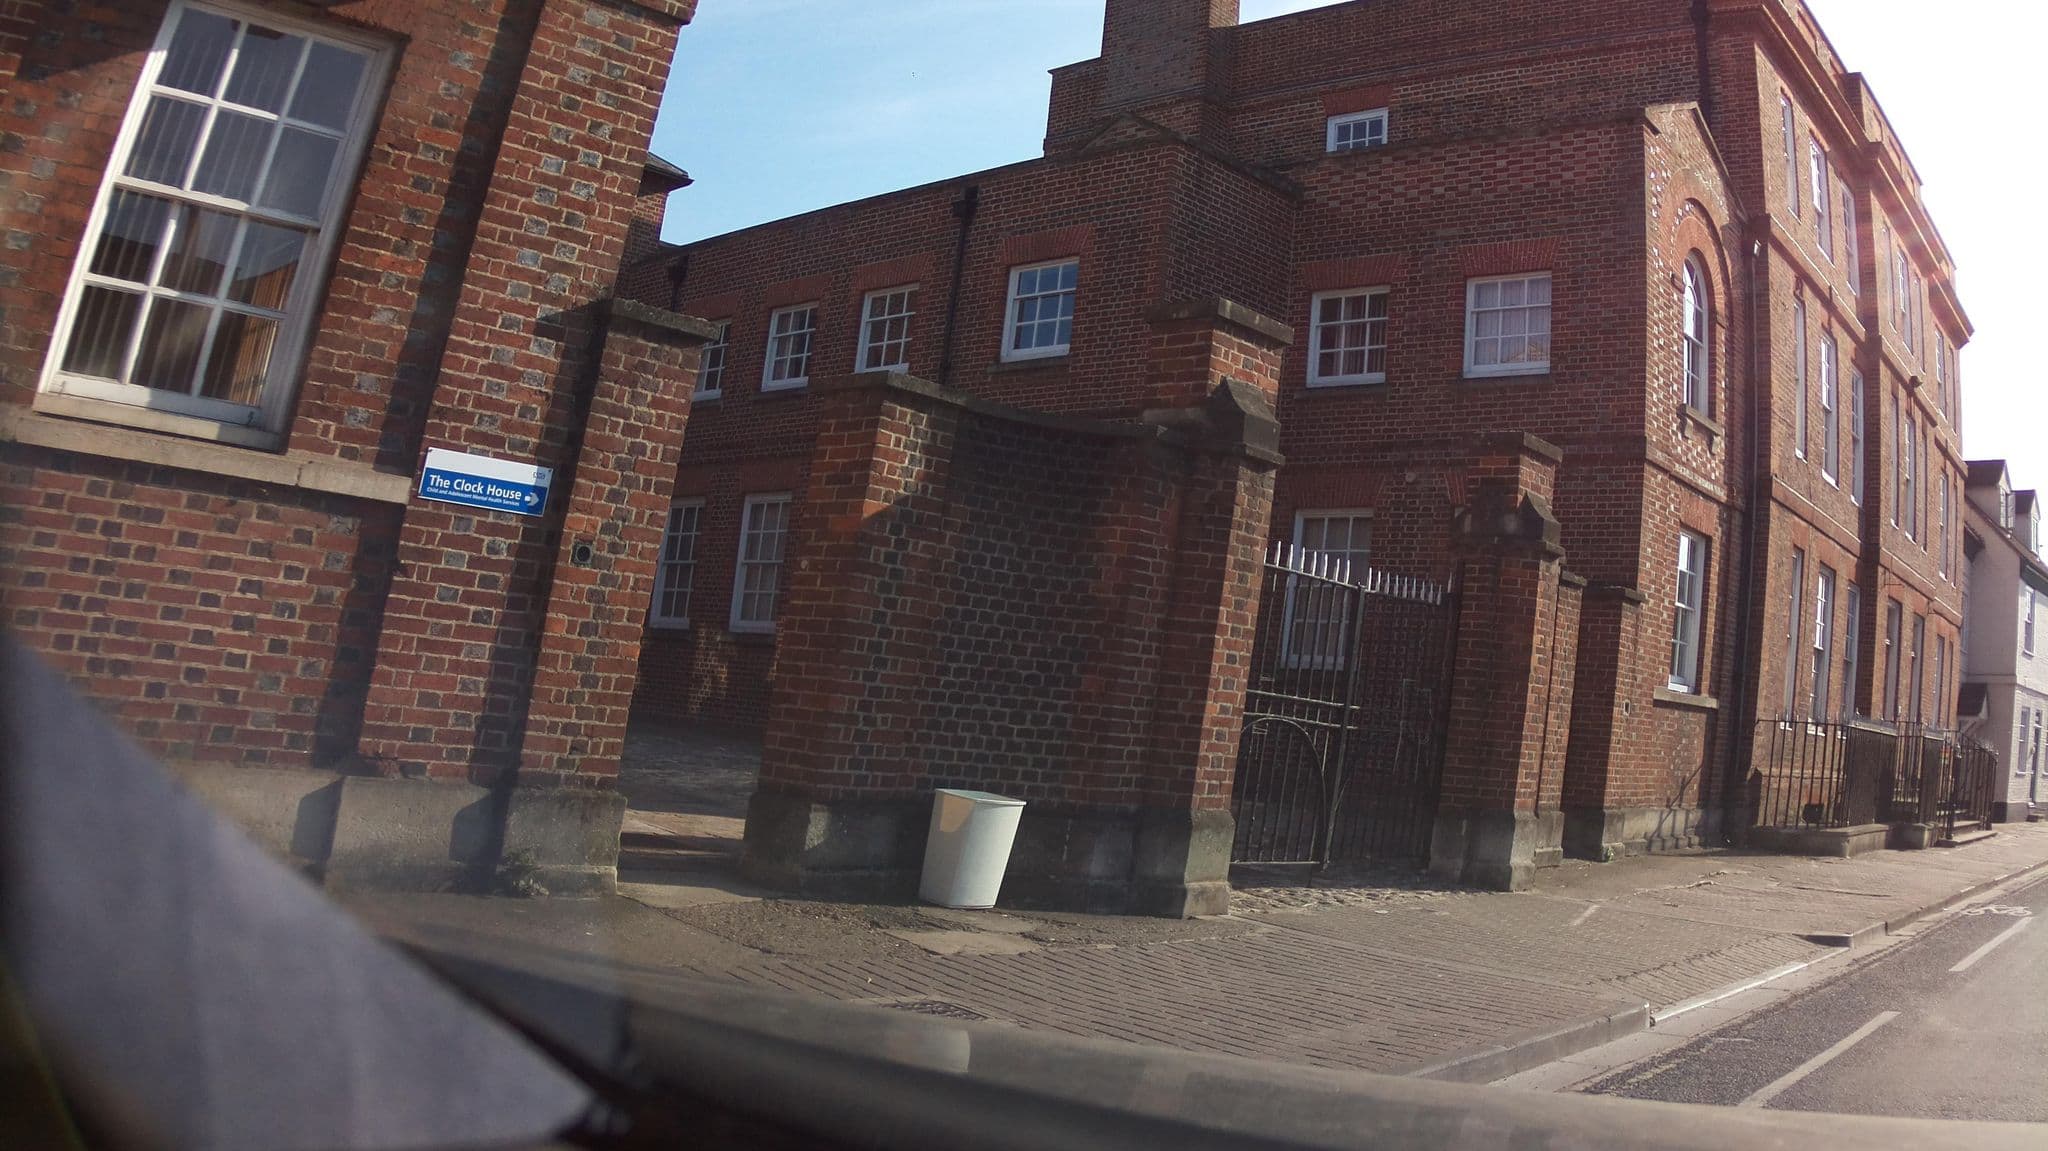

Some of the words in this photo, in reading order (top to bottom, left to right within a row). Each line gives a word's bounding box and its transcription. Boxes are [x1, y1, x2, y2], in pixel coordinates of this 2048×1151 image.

[430, 475, 450, 489] The
[454, 479, 484, 494] Clock
[487, 484, 521, 500] House
[448, 490, 472, 498] Adolescent
